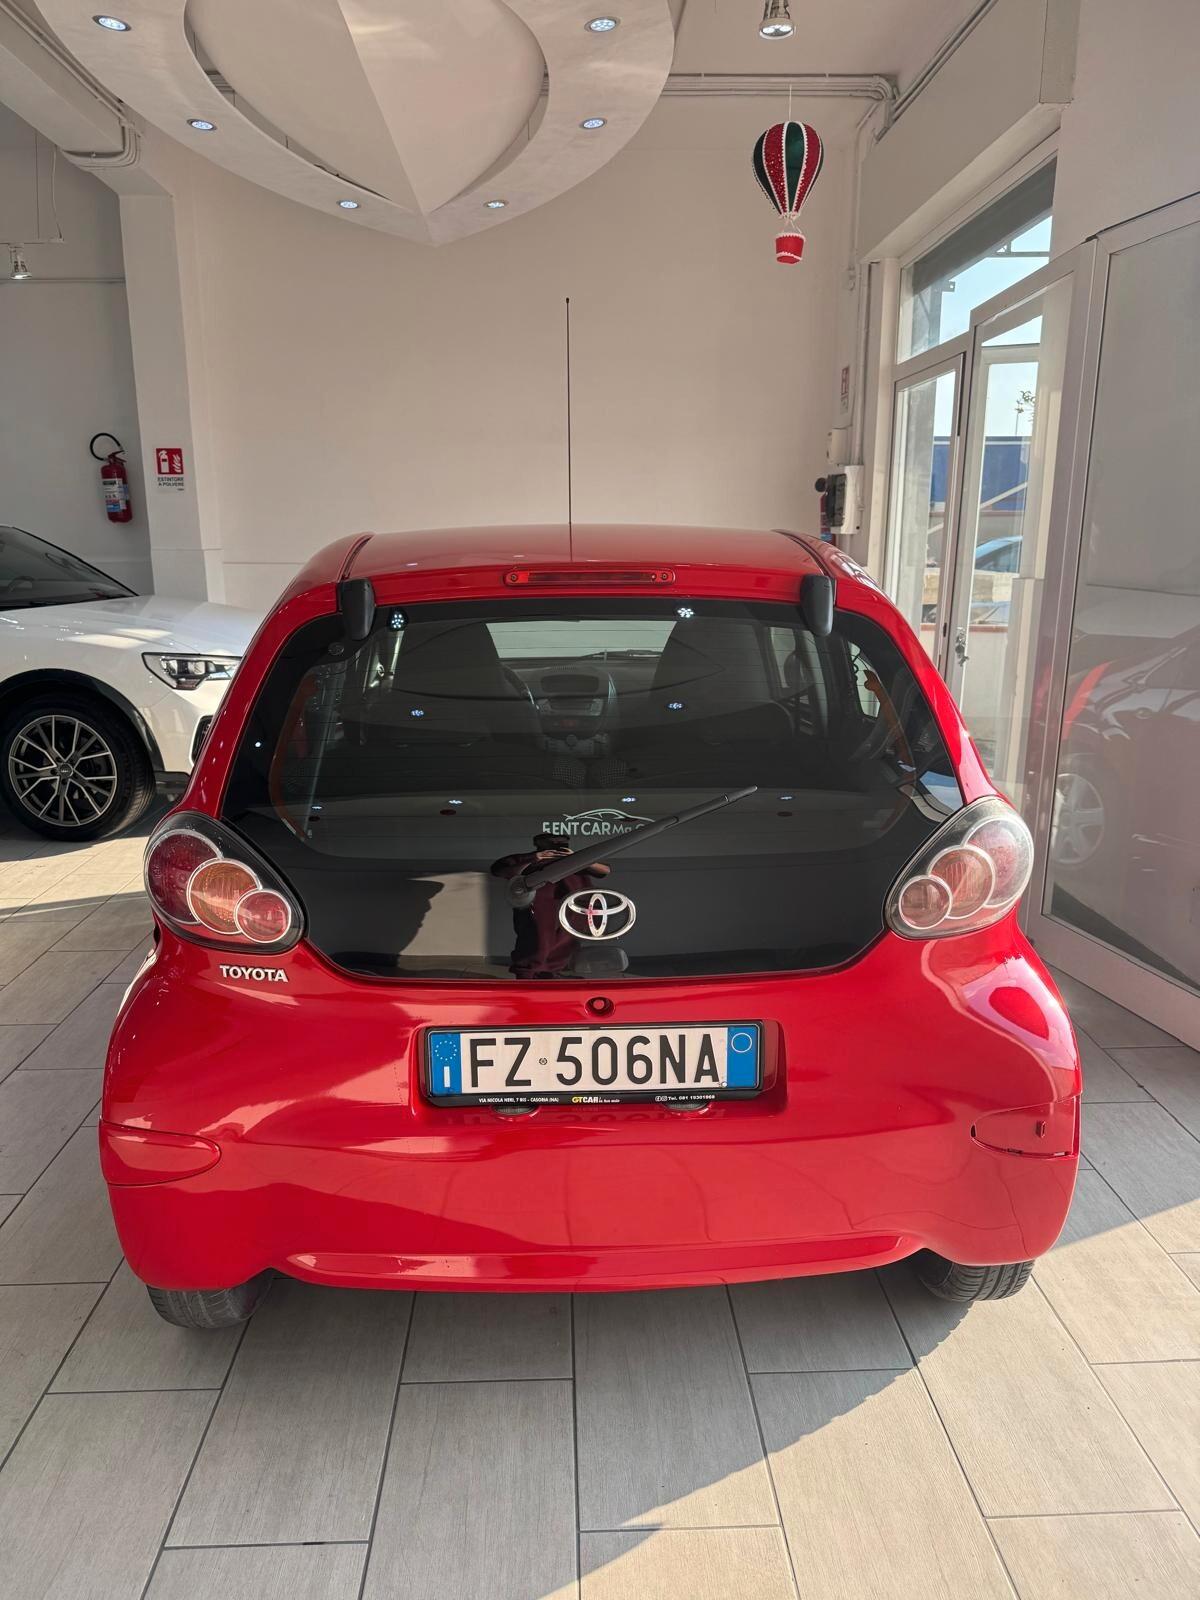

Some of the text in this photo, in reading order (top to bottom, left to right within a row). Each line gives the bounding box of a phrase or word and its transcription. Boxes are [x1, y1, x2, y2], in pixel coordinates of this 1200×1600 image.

[219, 964, 289, 983] TOYOTA
[470, 1033, 720, 1088] FZ 506NA
